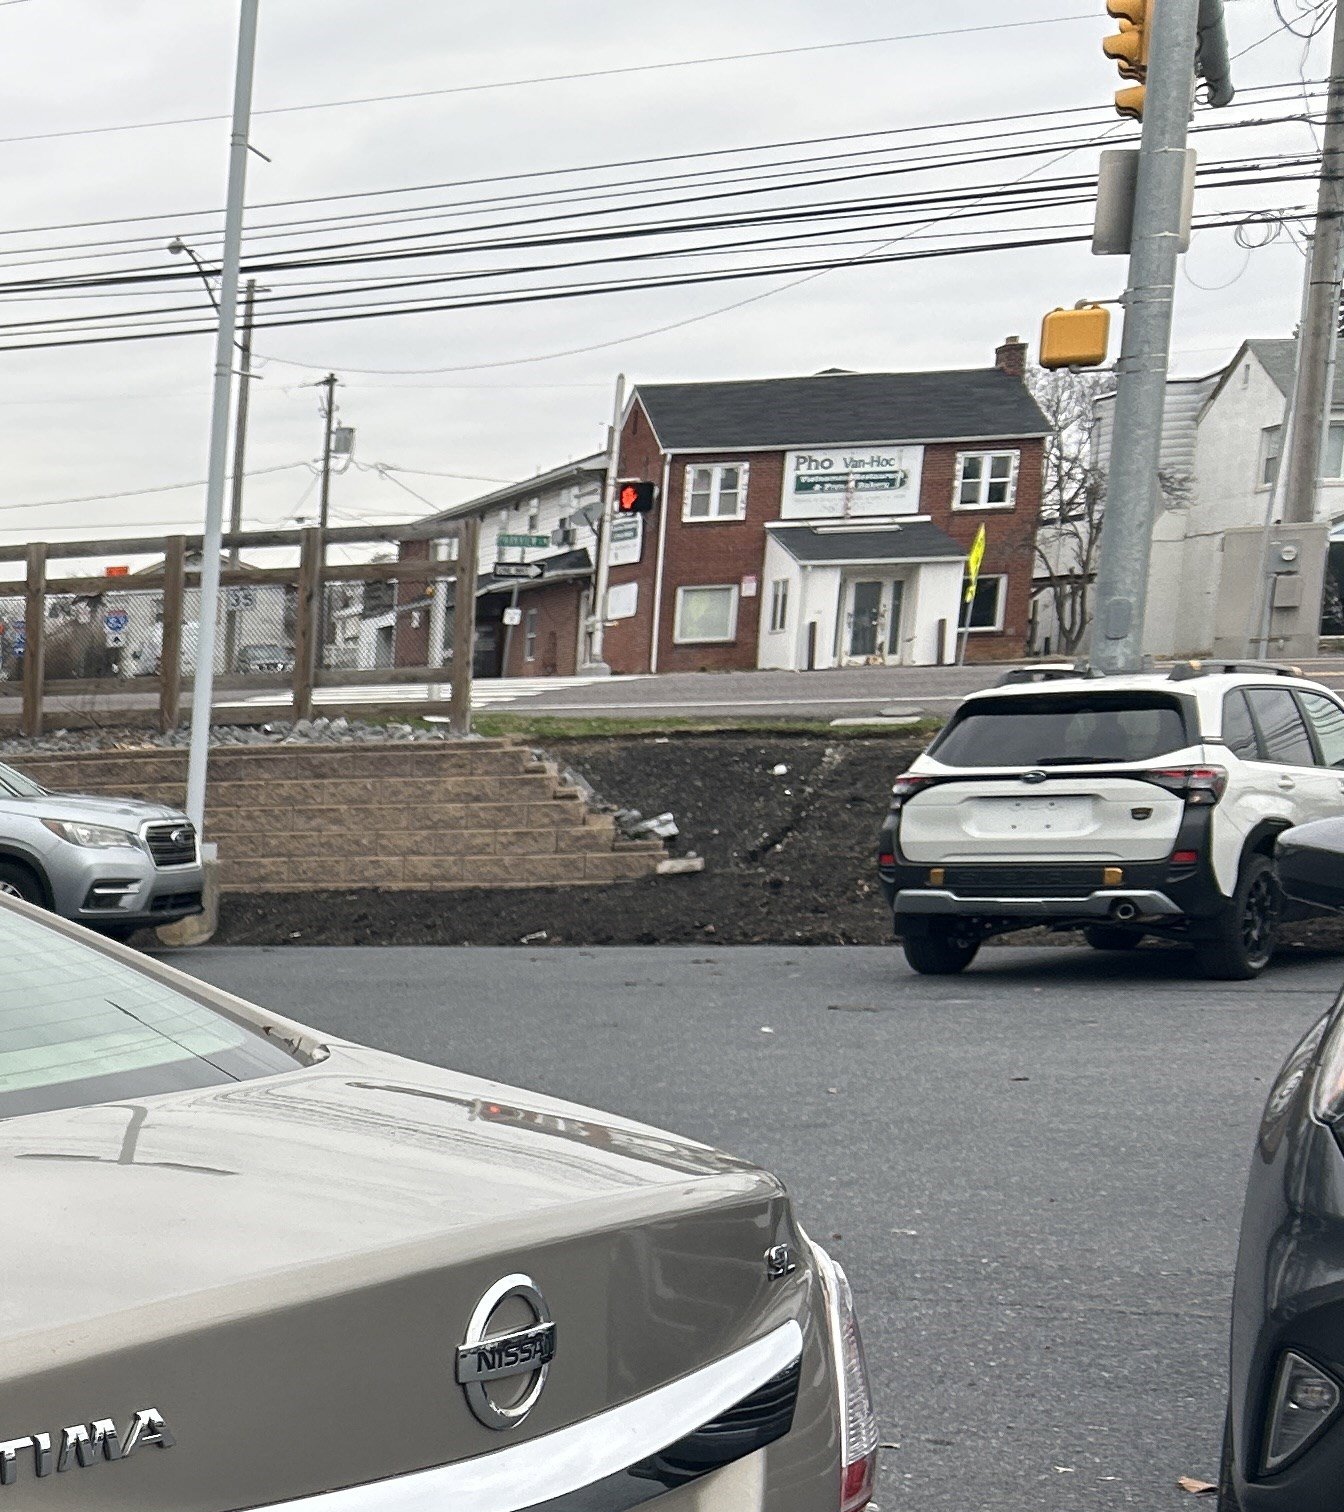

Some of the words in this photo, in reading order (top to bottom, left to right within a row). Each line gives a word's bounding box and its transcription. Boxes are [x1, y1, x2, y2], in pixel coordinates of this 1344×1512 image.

[794, 455, 834, 471] Pho
[843, 455, 895, 469] Van-Hoc
[476, 1332, 555, 1373] NISSAN
